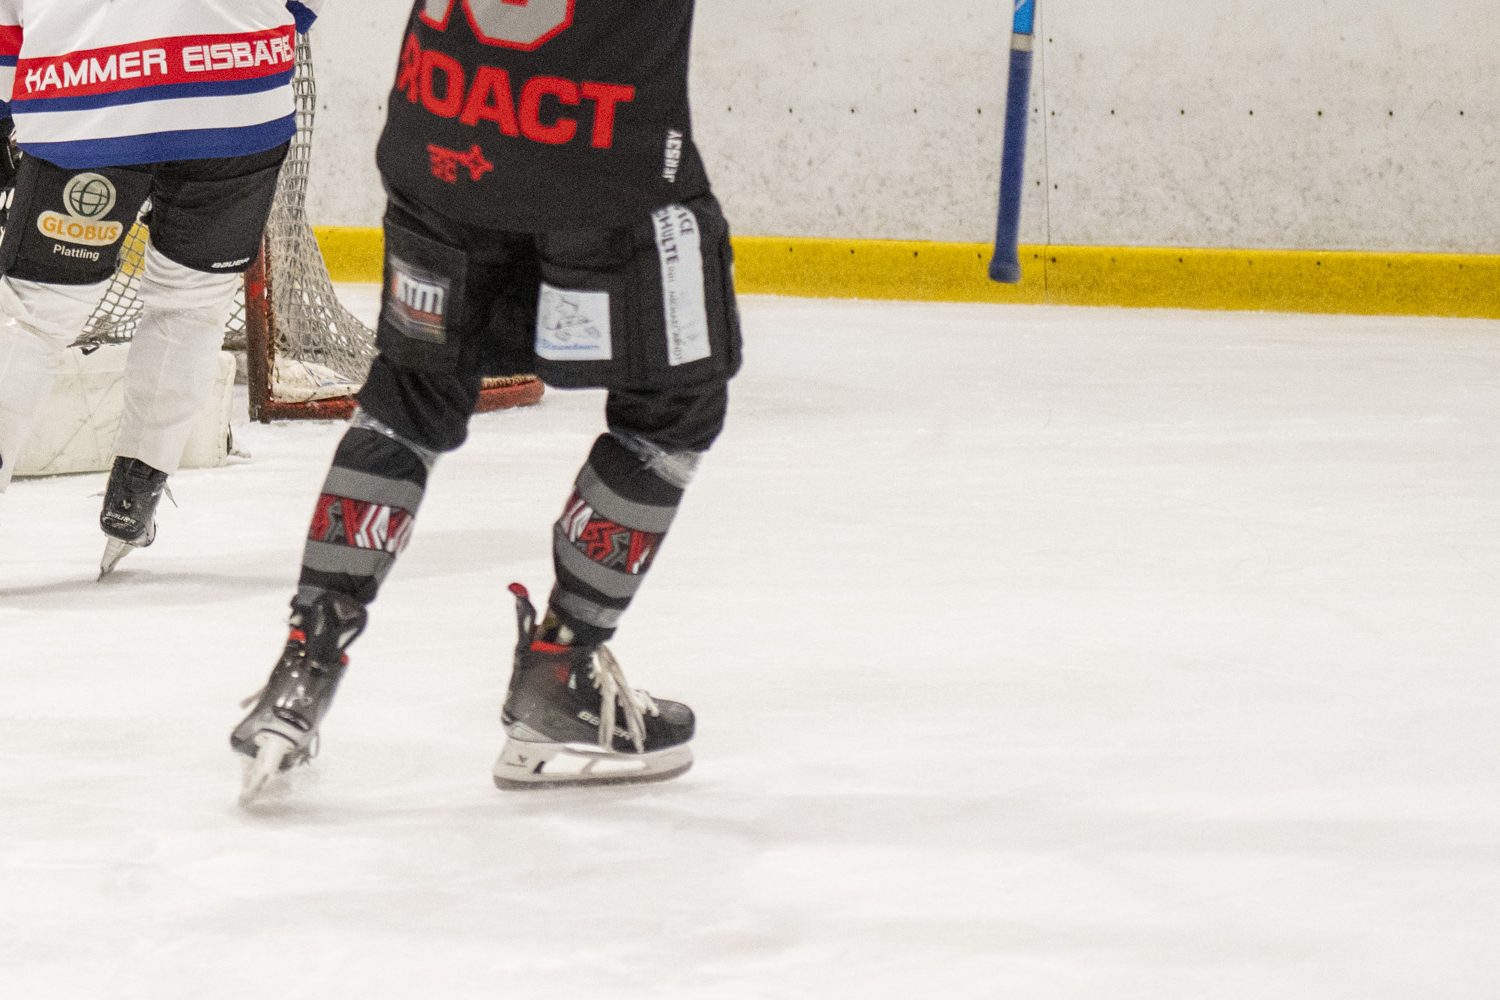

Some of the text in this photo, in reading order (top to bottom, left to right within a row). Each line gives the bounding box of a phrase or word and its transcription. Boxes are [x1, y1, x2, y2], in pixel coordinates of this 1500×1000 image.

[25, 34, 295, 93] HAMMER EISBÄRE
[398, 33, 636, 149] ROACT
[41, 215, 121, 242] GLOBUS
[52, 244, 100, 262] Plattling
